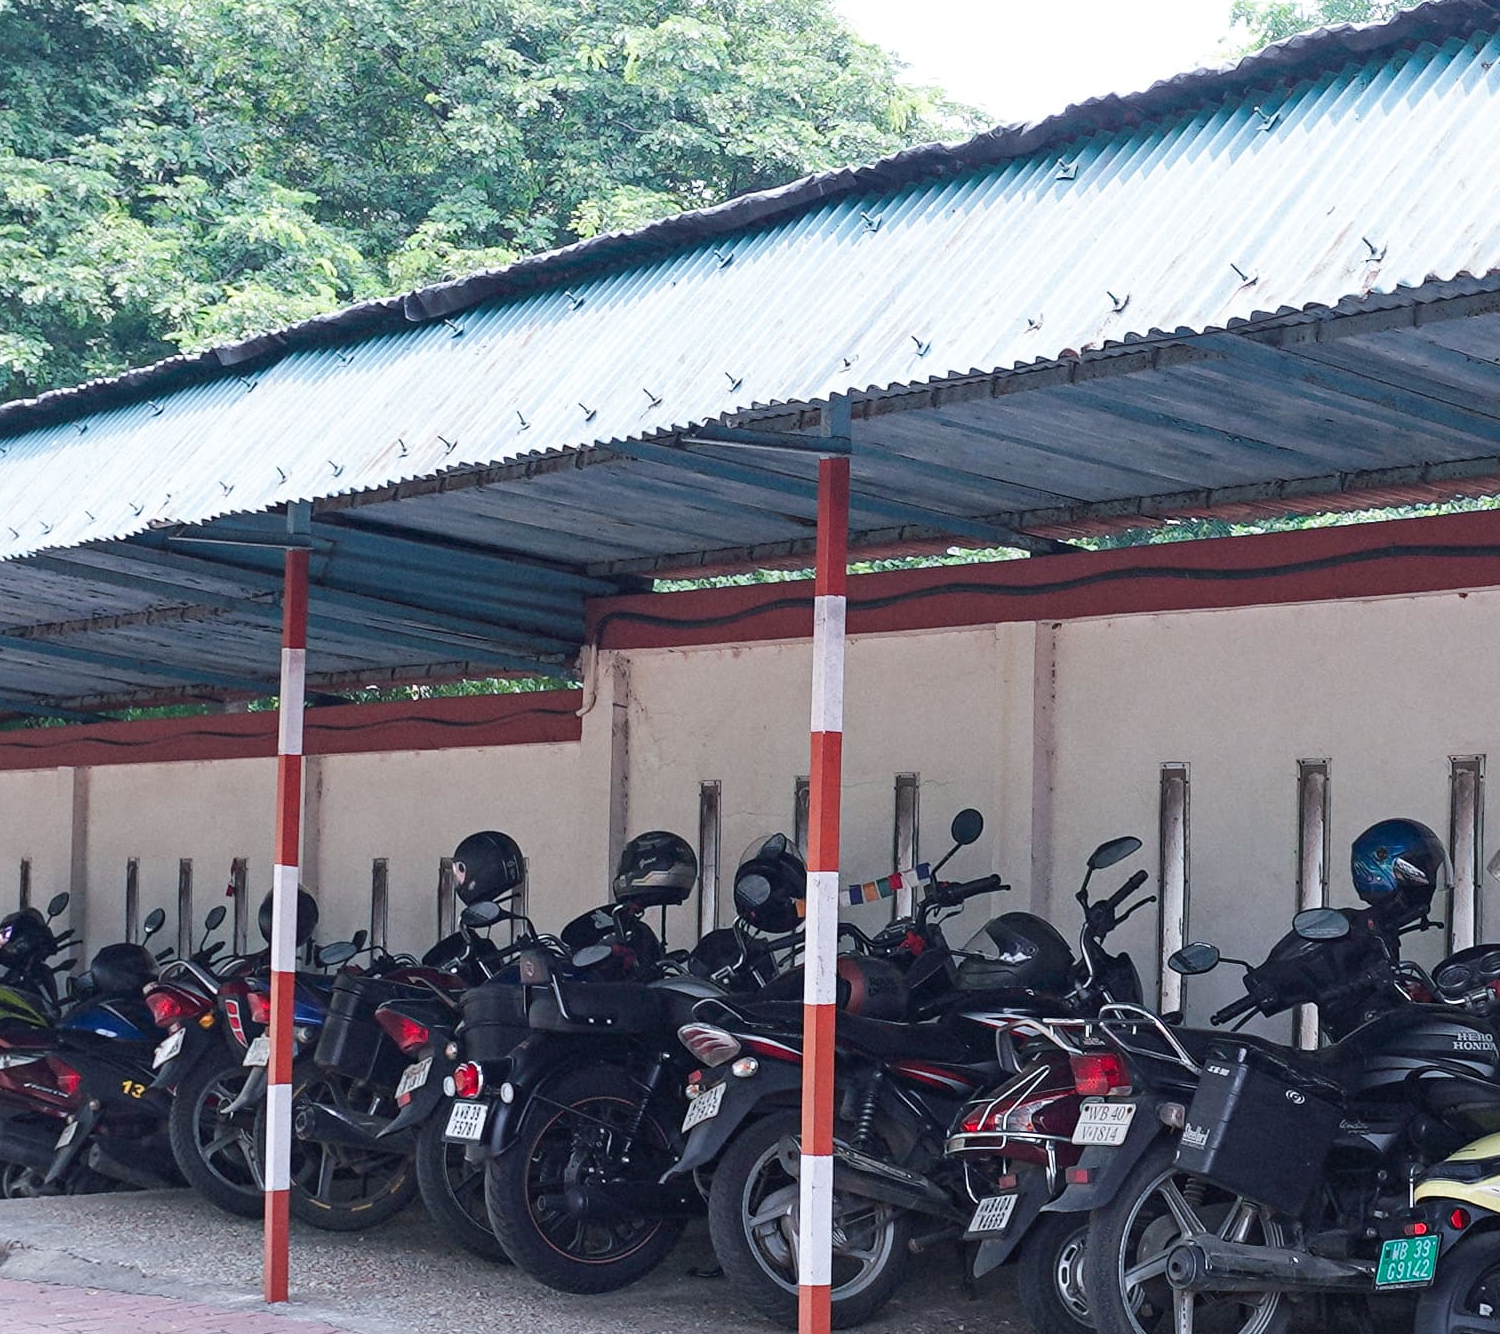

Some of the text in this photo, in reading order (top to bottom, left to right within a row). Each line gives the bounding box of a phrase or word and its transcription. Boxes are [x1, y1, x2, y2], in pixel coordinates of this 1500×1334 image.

[121, 1080, 146, 1099] 13
[1088, 1106, 1127, 1121] WB 40
